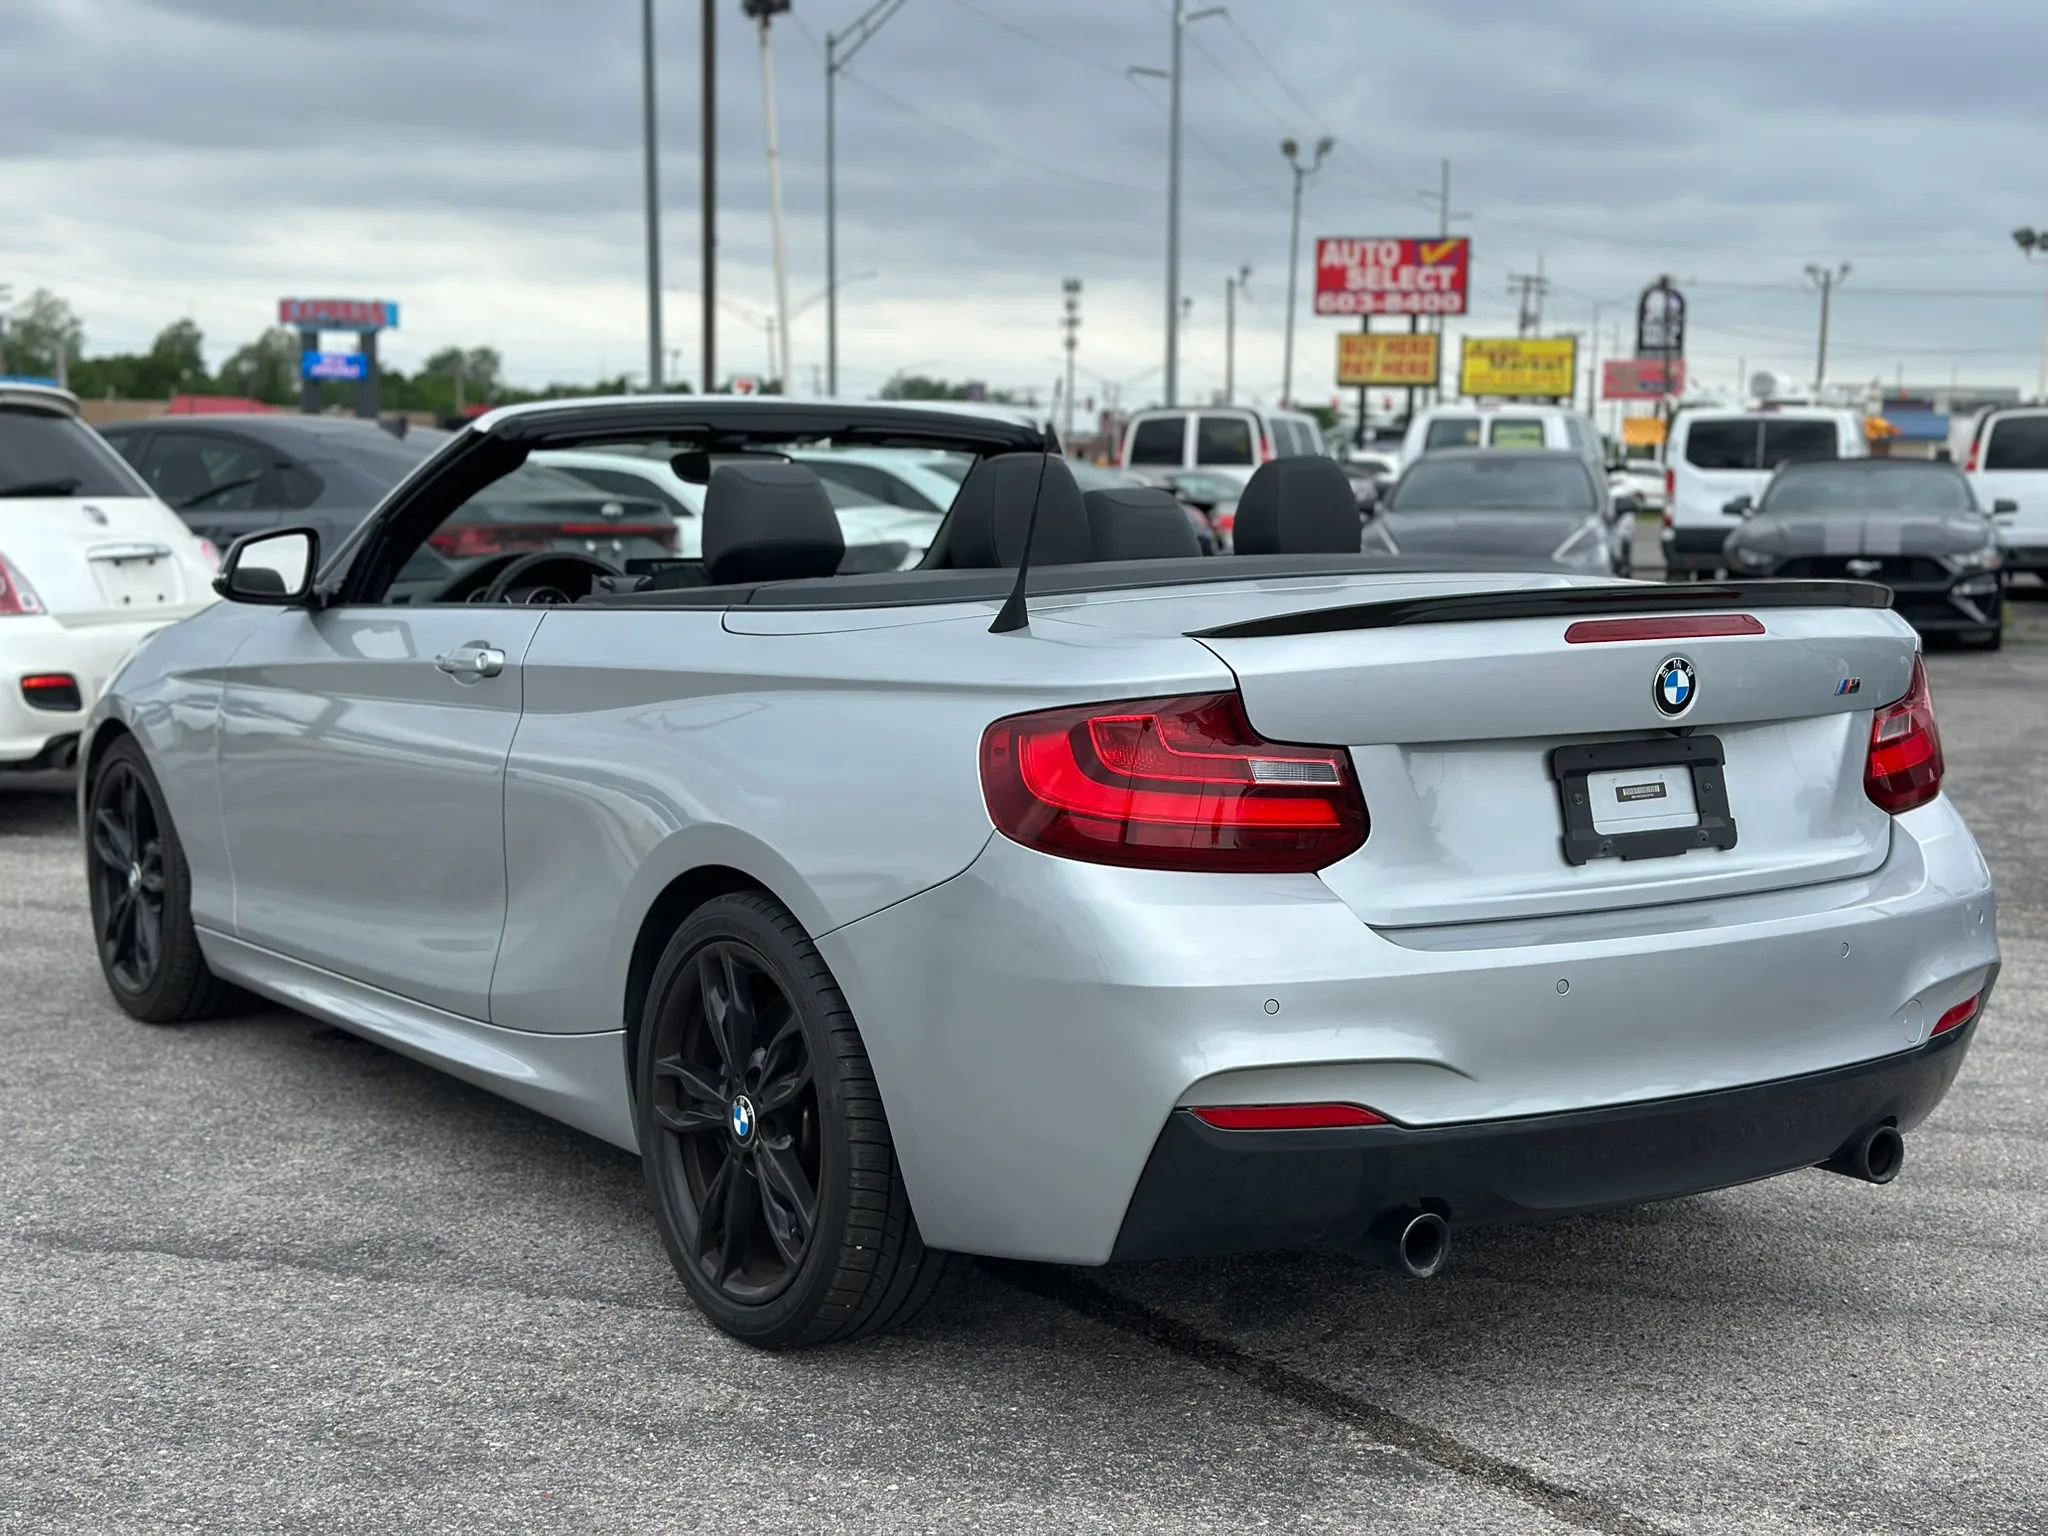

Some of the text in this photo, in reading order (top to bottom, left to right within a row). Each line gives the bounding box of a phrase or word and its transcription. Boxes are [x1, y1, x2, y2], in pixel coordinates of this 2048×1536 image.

[1320, 240, 1402, 267] AUTO
[1345, 265, 1458, 291] SELECT
[1386, 339, 1432, 355] HERE
[1382, 361, 1431, 376] HERE
